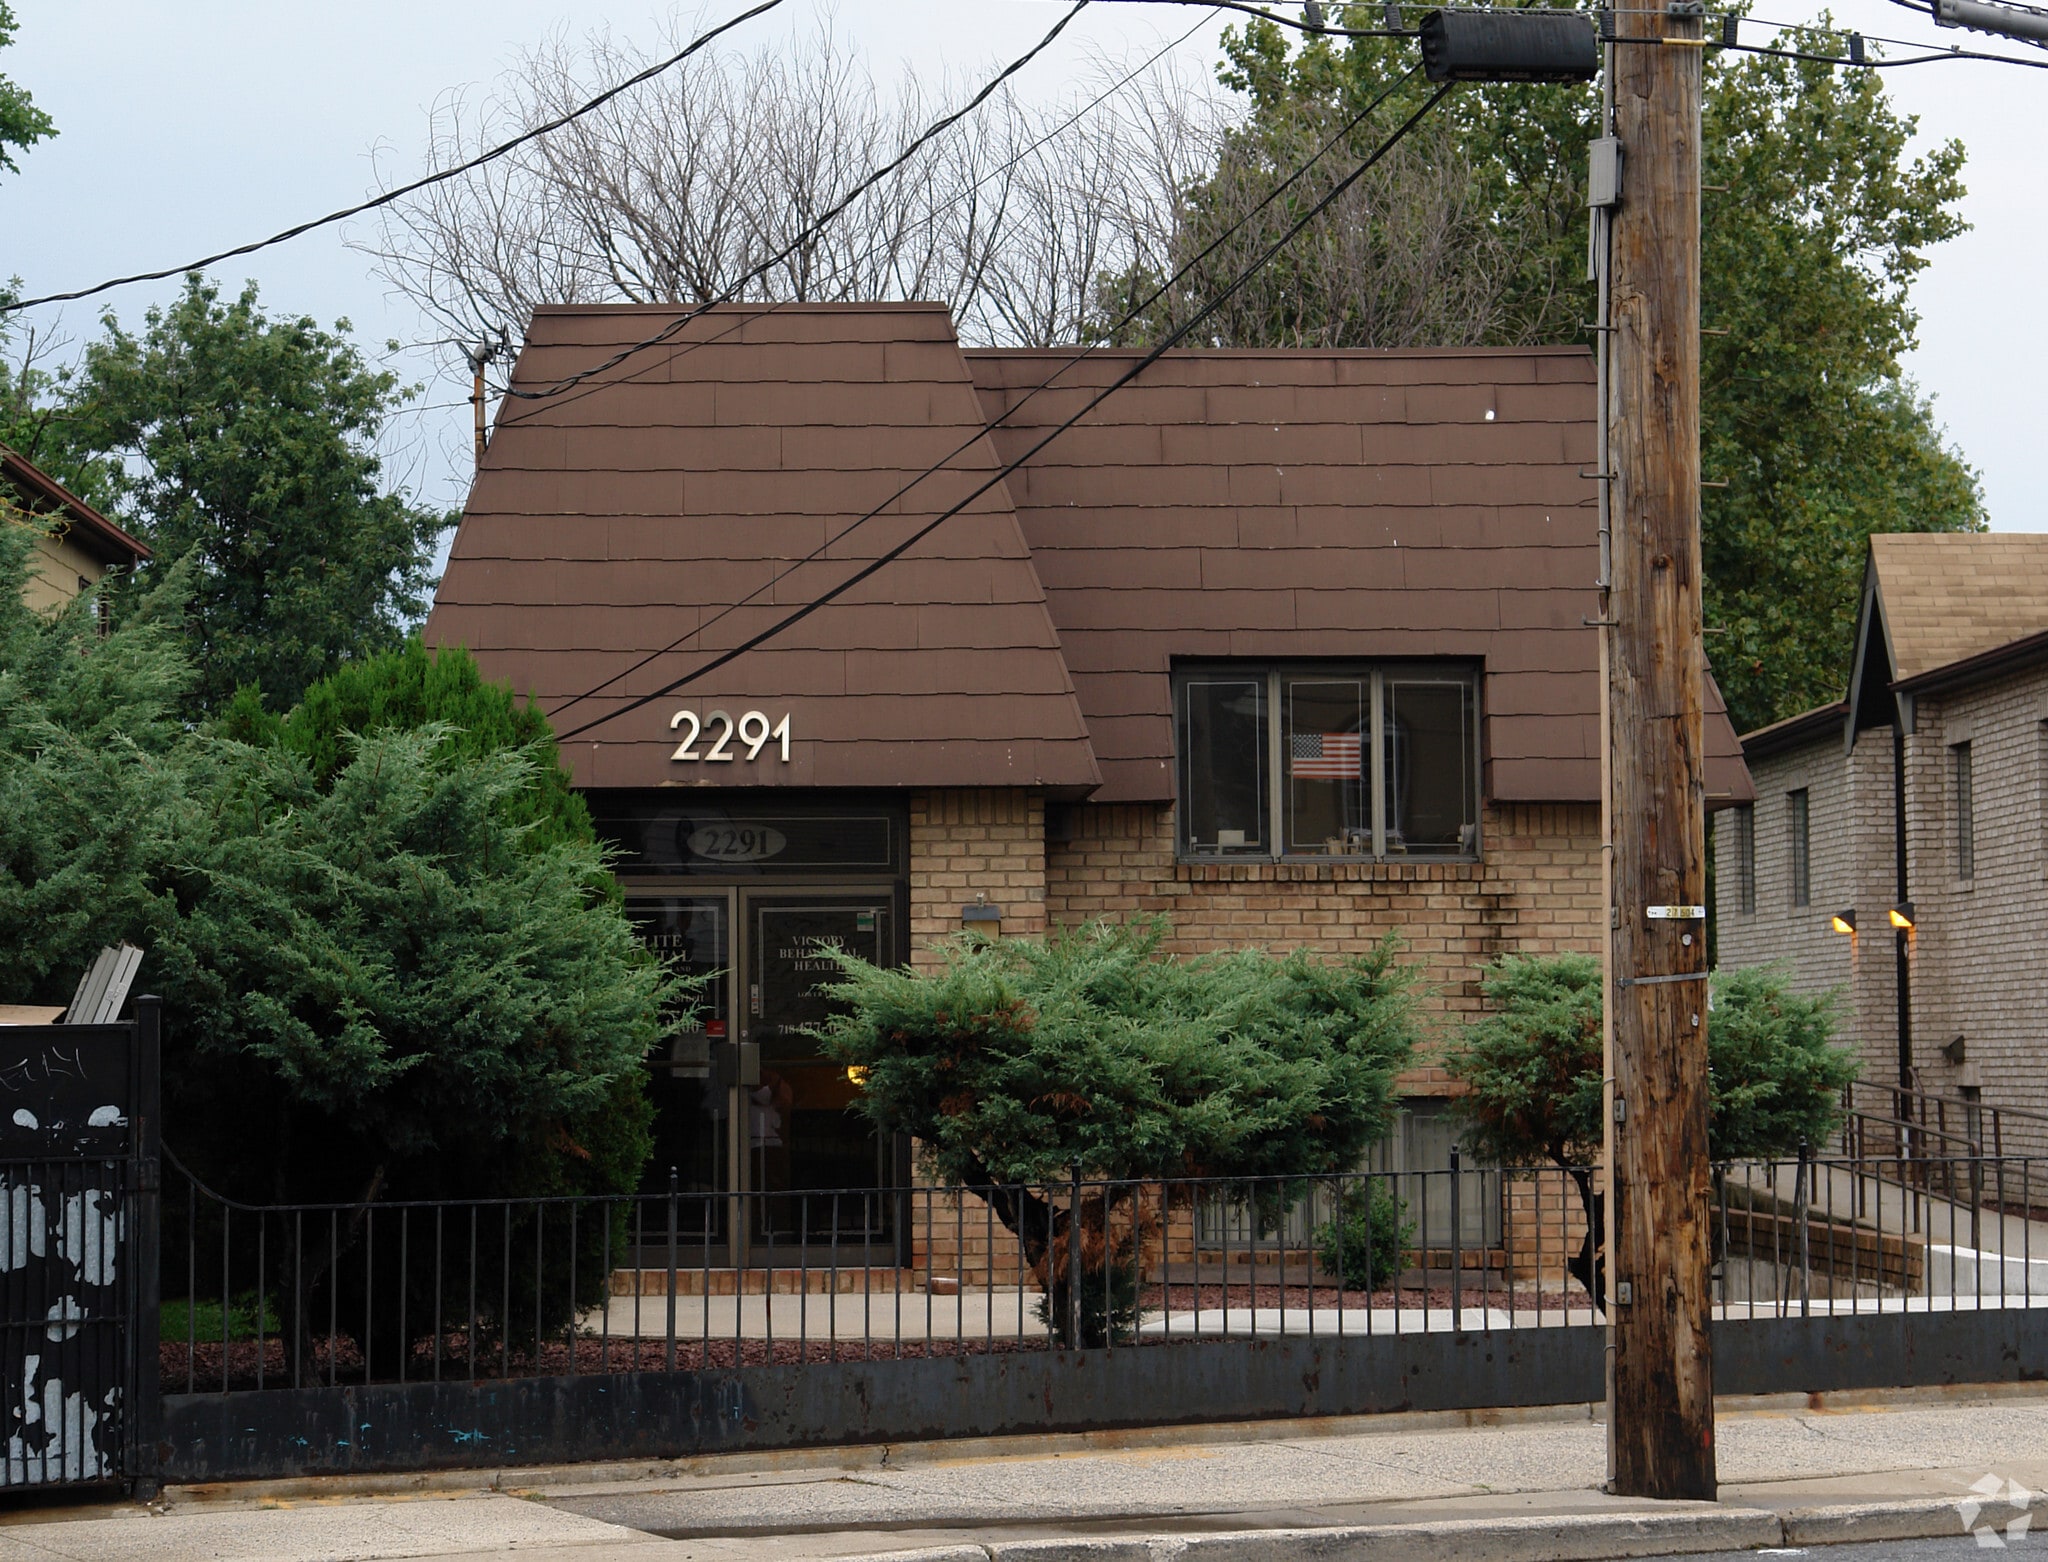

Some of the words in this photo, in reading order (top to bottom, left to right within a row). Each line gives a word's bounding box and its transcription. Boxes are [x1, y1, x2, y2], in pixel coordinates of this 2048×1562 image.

[670, 710, 790, 761] 2291
[704, 829, 769, 855] 2291
[634, 934, 683, 948] LITE
[792, 935, 847, 946] VICTORY
[779, 948, 860, 959] BEHAAL
